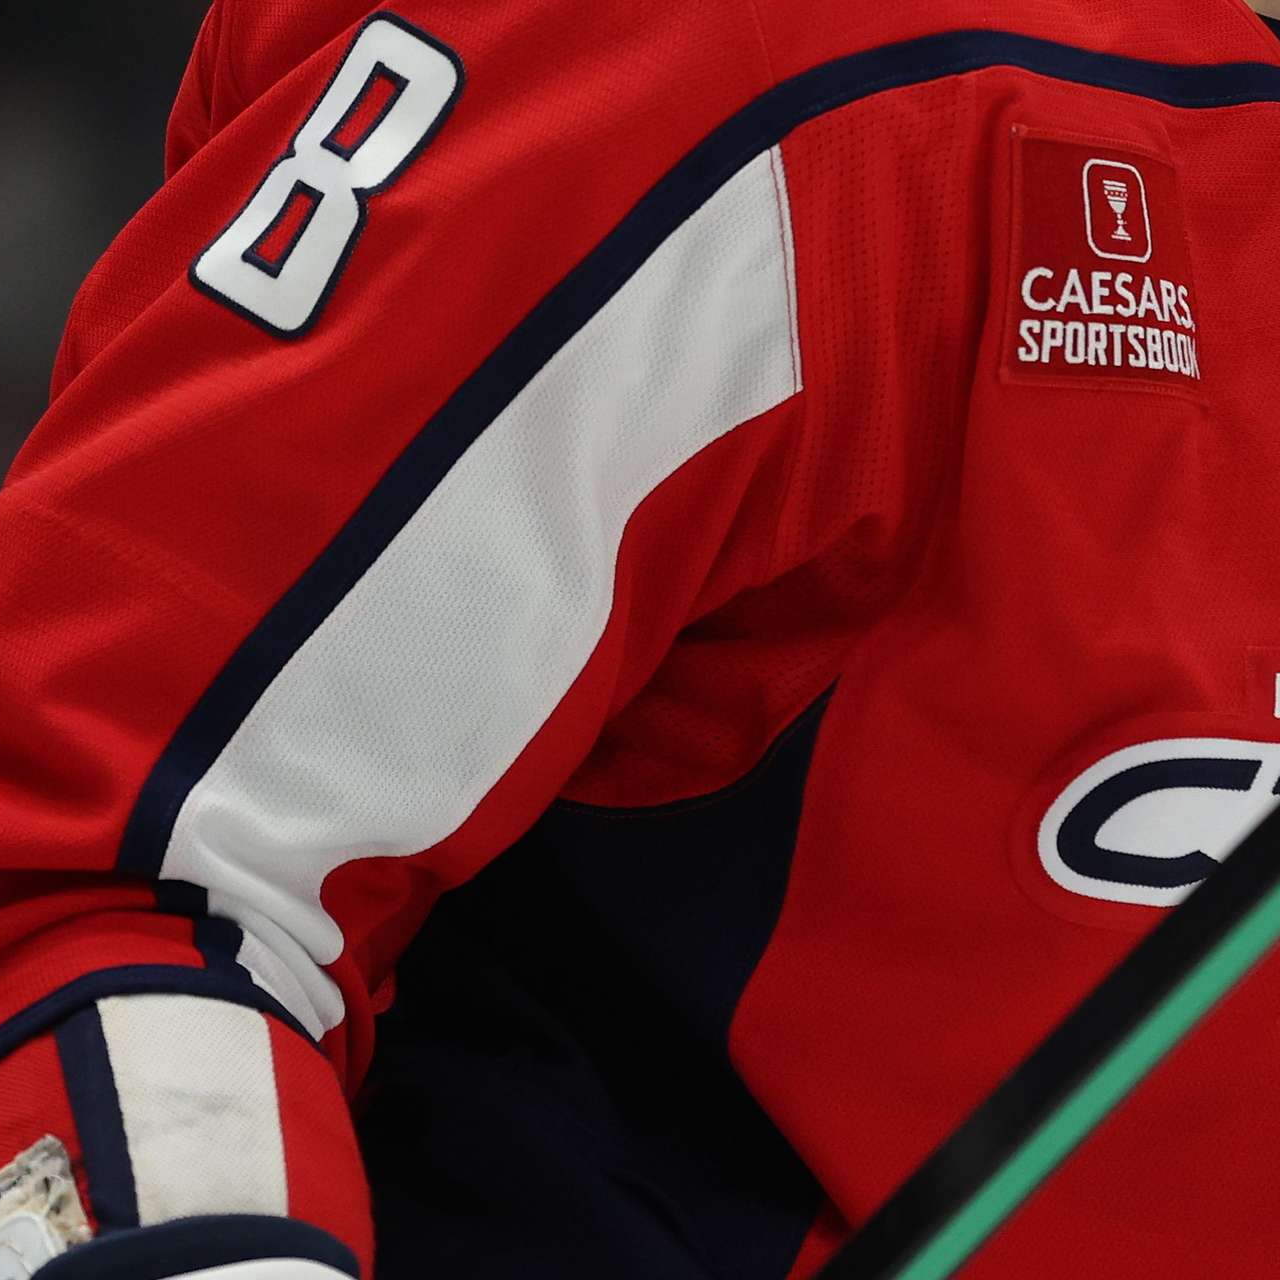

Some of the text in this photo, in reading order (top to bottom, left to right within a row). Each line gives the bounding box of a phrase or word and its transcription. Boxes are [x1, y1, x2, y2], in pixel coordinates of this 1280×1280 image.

[188, 9, 466, 341] 8
[1021, 267, 1195, 330] CAESARS
[1017, 319, 1200, 380] SPORTSBOOK
